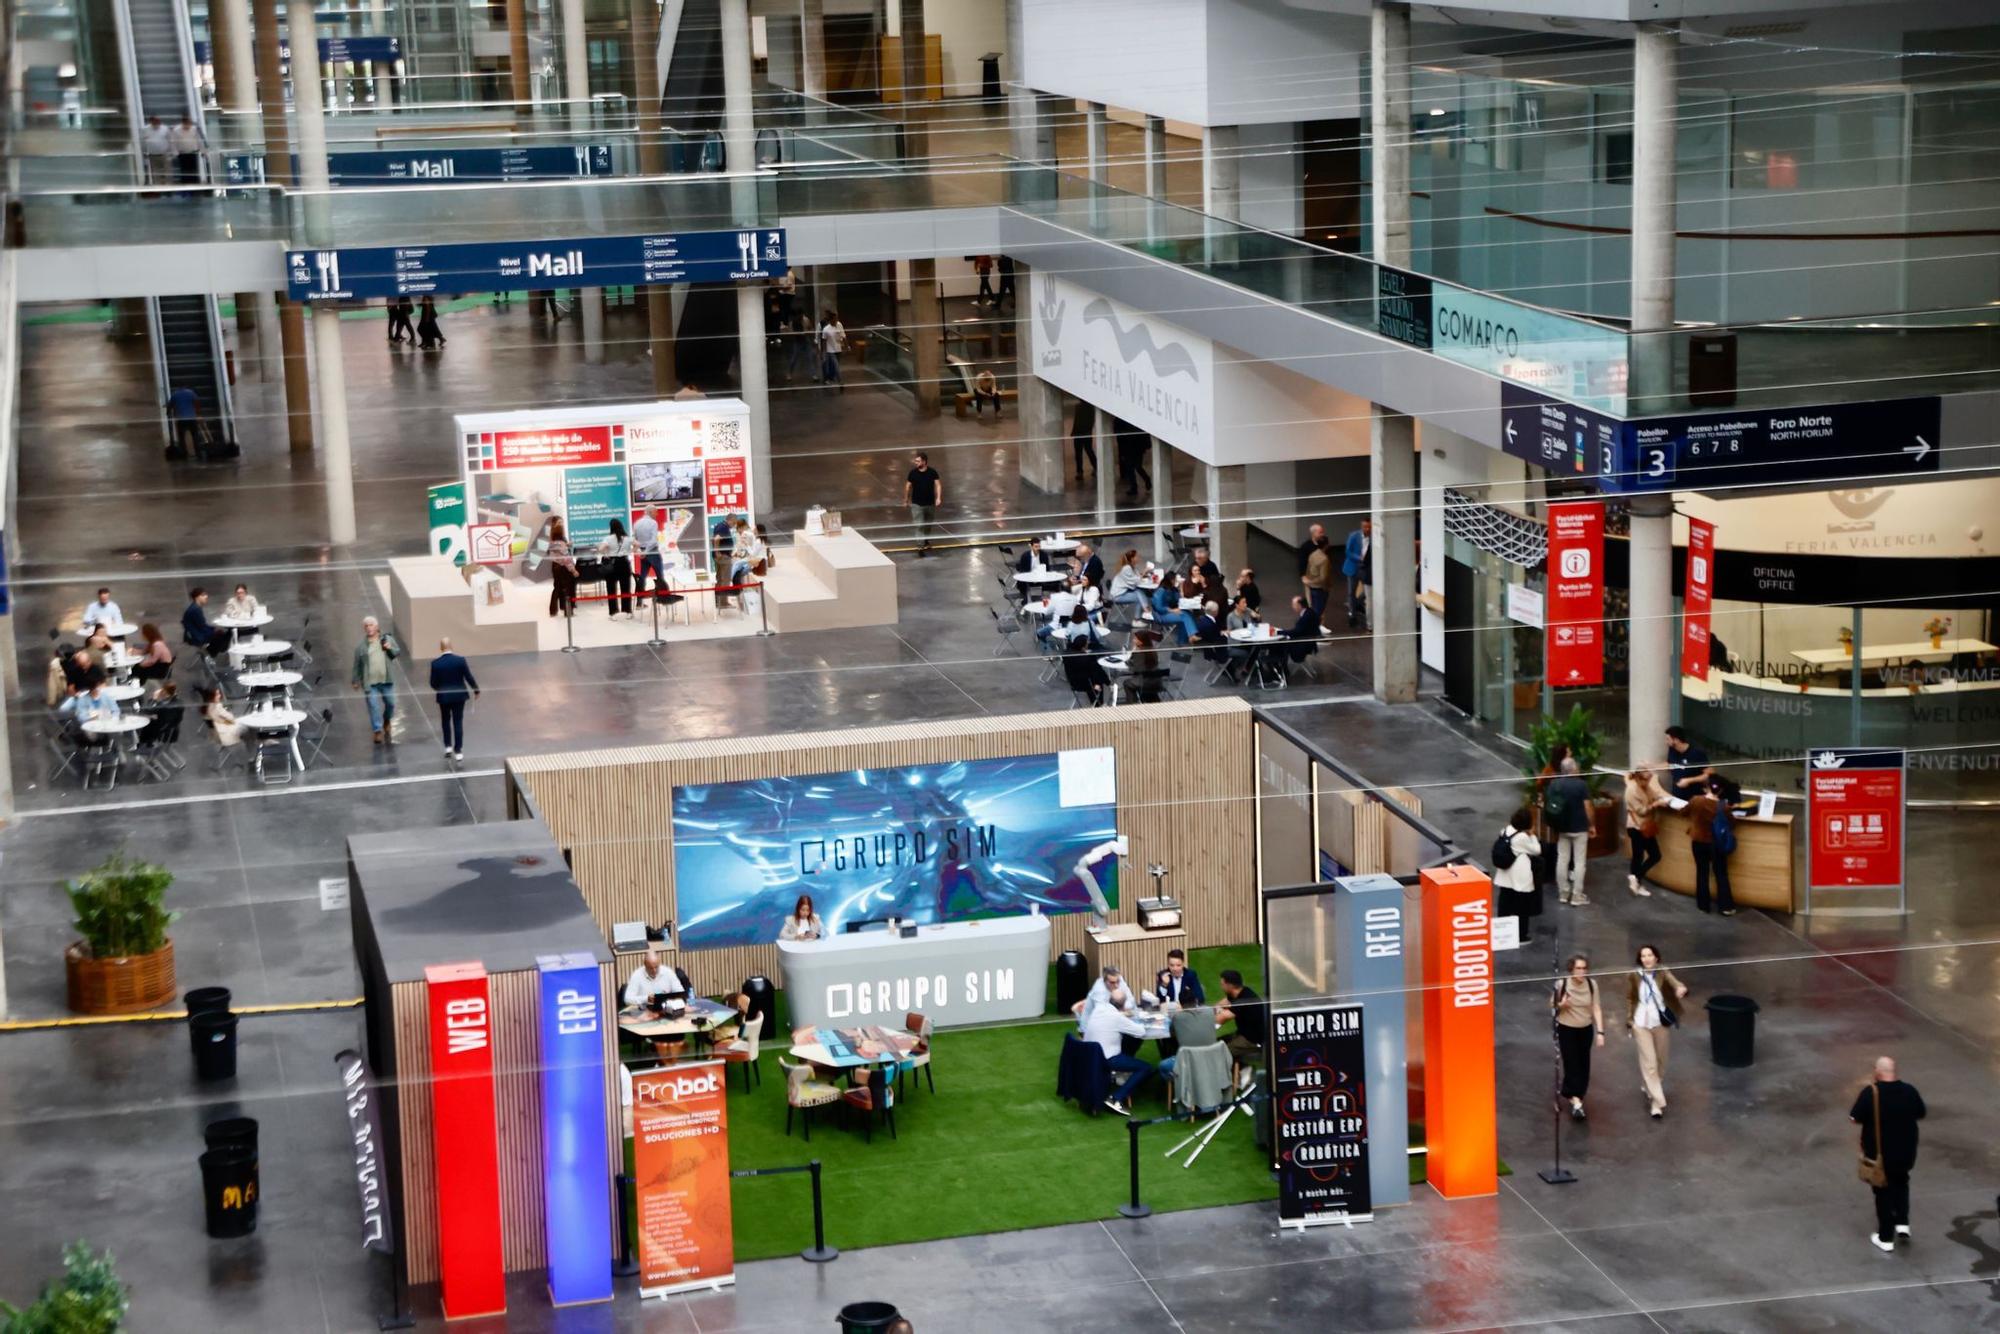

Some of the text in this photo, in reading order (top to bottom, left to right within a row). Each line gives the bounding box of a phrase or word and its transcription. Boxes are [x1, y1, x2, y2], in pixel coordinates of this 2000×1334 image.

[411, 158, 454, 178] Mall
[500, 257, 520, 267] Nivel
[501, 267, 521, 276] Level
[528, 250, 583, 278] Mall
[1439, 307, 1518, 358] GOMARCO
[1083, 350, 1199, 435] FERIA VALENCIA
[1770, 416, 1832, 429] Foro Norte
[1770, 428, 1833, 441] NORTH FORUM
[1691, 440, 1739, 454] 6 7 8
[1603, 447, 1612, 474] 3
[1649, 450, 1665, 476] 3
[1785, 533, 1937, 553] FERIA VALENCIA
[1753, 567, 1795, 579] OFICINA
[1758, 579, 1795, 591] OFFICE
[1708, 691, 1813, 716] BIENVENUS
[834, 824, 997, 872] GRUPO SIM
[1365, 906, 1401, 958] RFID
[1453, 898, 1490, 1008] ROBOTICA
[858, 968, 1014, 1014] GRUPO SIM
[557, 988, 597, 1035] ERP
[446, 997, 488, 1054] WEB
[1277, 1011, 1359, 1036] GRUPO SIM
[1292, 1095, 1321, 1112] RFID
[645, 1128, 702, 1144] SOLUCIONES
[1282, 1117, 1363, 1138] GESTIÓN ERP
[1300, 1143, 1360, 1161] ROBÓTICA
